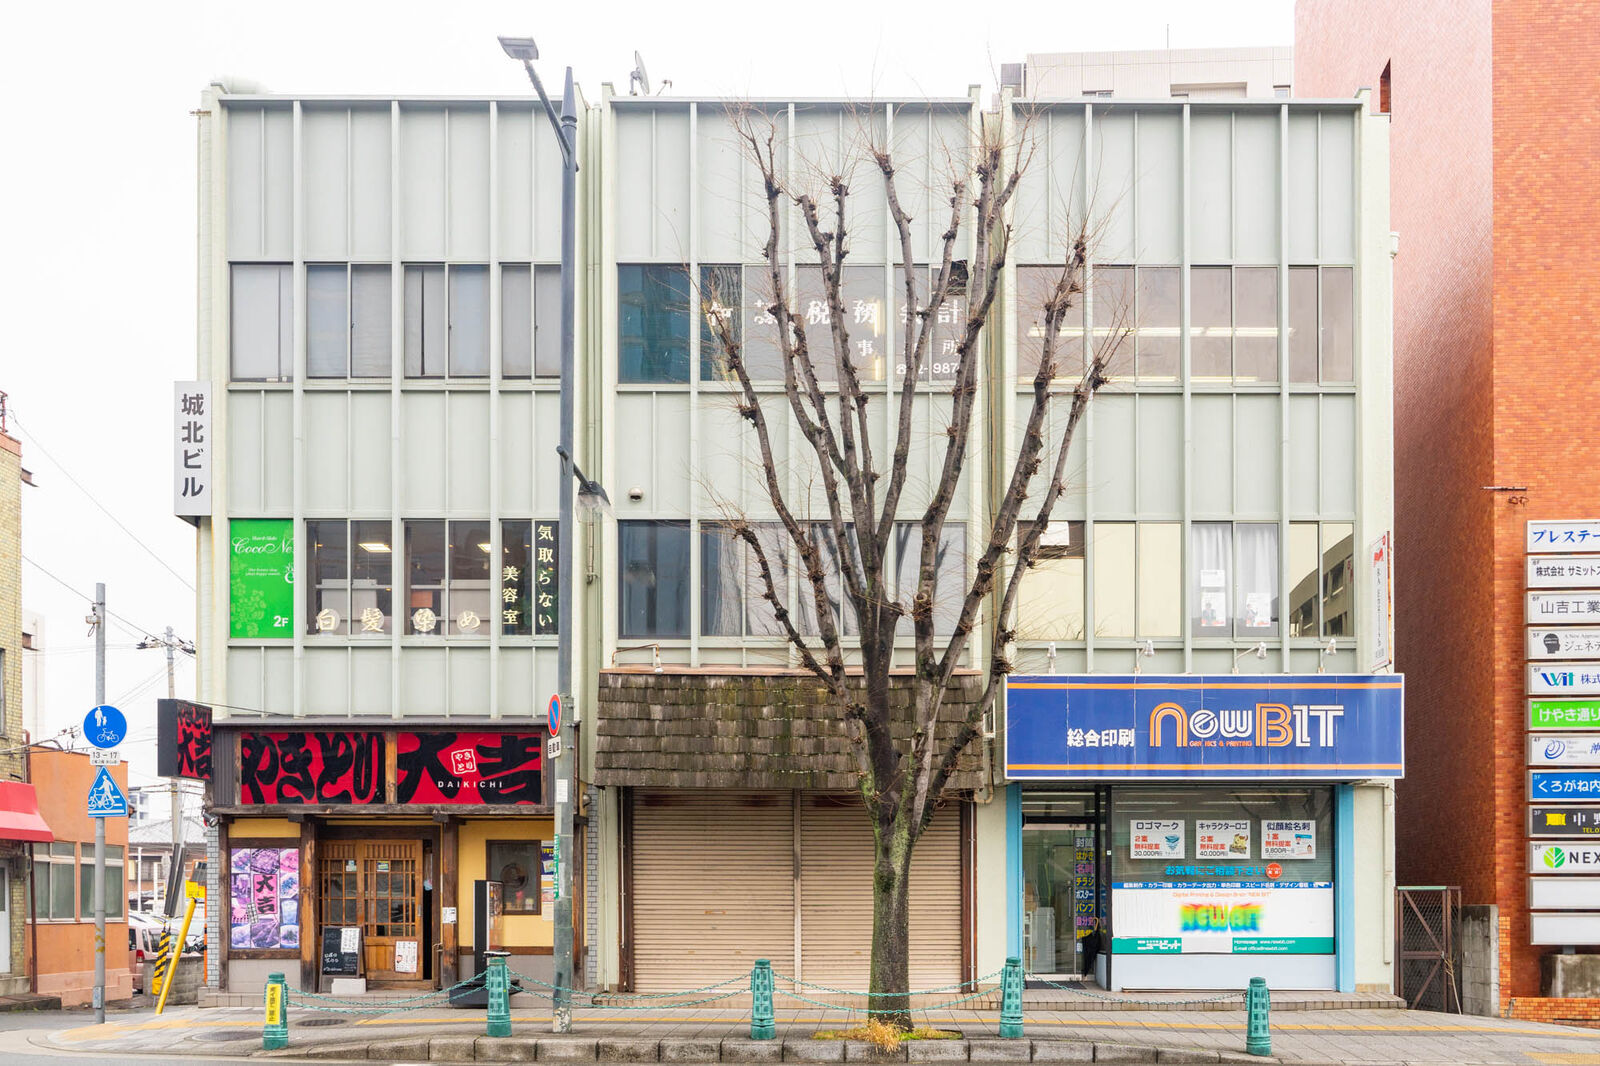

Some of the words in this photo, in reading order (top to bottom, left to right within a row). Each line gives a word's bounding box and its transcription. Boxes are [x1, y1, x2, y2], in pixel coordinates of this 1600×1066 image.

[181, 393, 204, 497] 城北ビル
[537, 524, 554, 628] 気取らない
[1536, 567, 1564, 577] 株式会社
[502, 565, 519, 626] 美容室
[273, 615, 289, 628] 2F
[1067, 728, 1135, 748] 総合印刷
[437, 780, 503, 788] DAIKICHI
[1136, 822, 1179, 830] ロゴマーク
[1199, 822, 1248, 830] キャラクターロゴ
[1075, 877, 1094, 886] チラシ
[256, 876, 275, 913] 大吉
